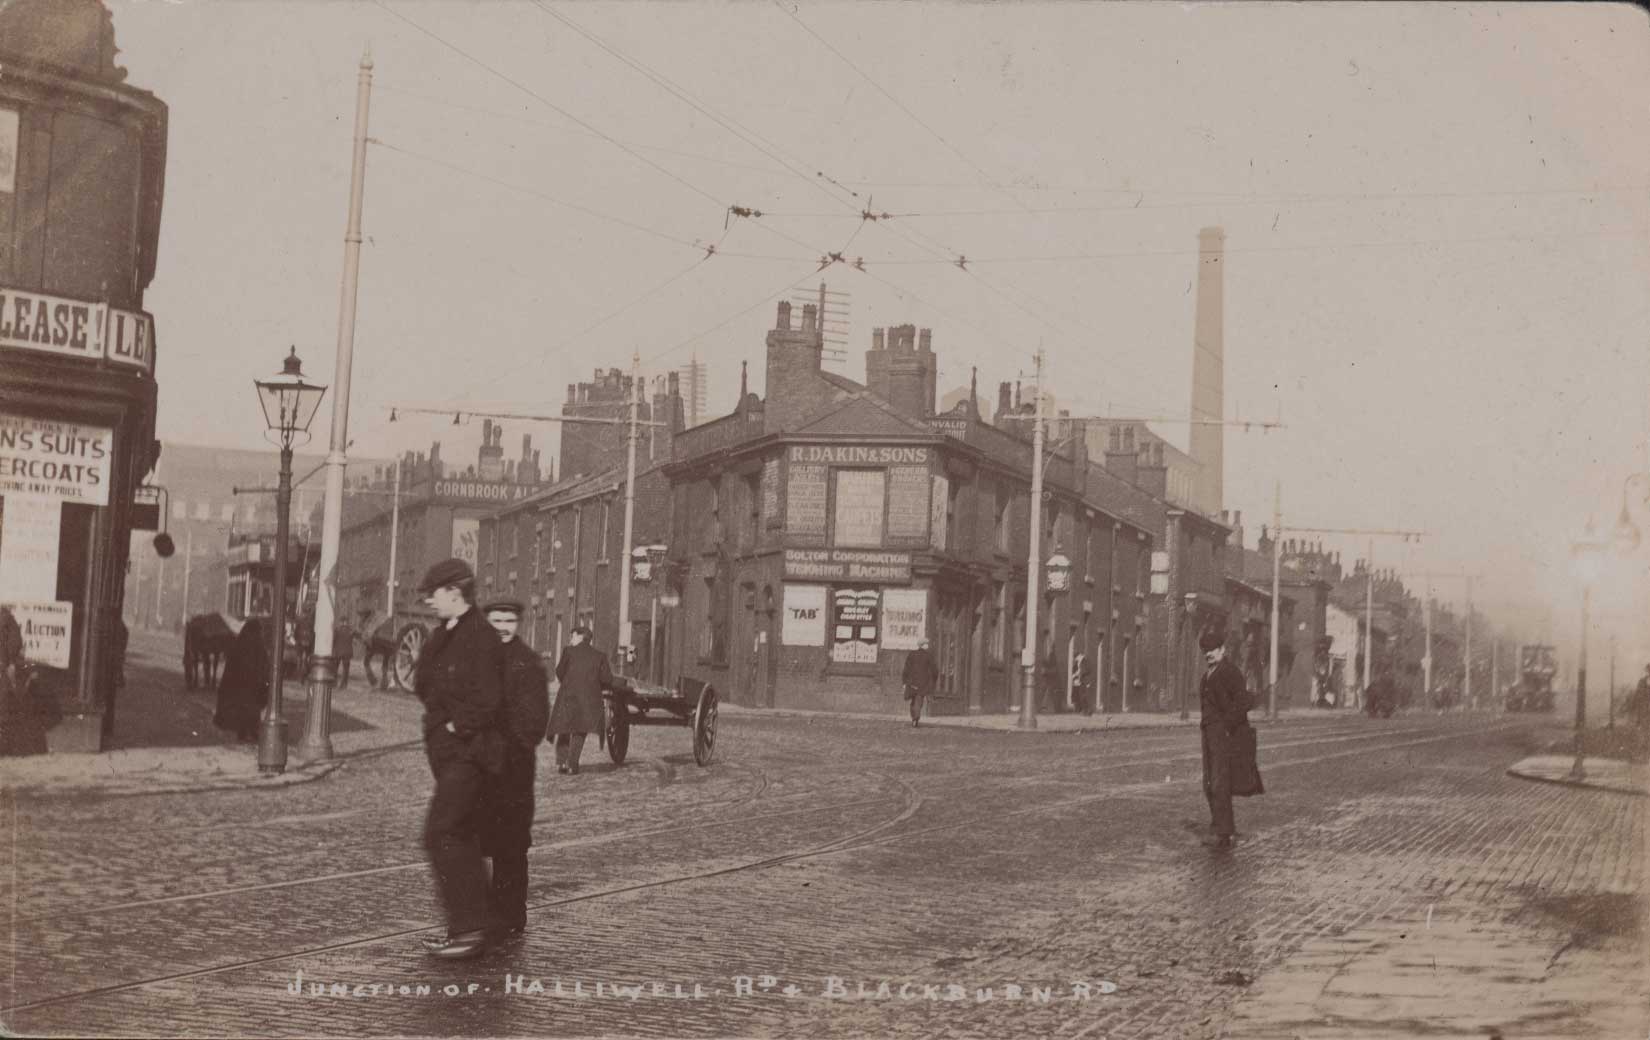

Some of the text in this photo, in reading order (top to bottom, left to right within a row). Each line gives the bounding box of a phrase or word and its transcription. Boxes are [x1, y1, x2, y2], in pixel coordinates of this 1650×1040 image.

[40, 433, 106, 459] SUITS
[434, 480, 508, 501] CORNBROOK
[785, 549, 910, 564] BOLTON CORPORATION
[25, 618, 66, 638] AUCTION
